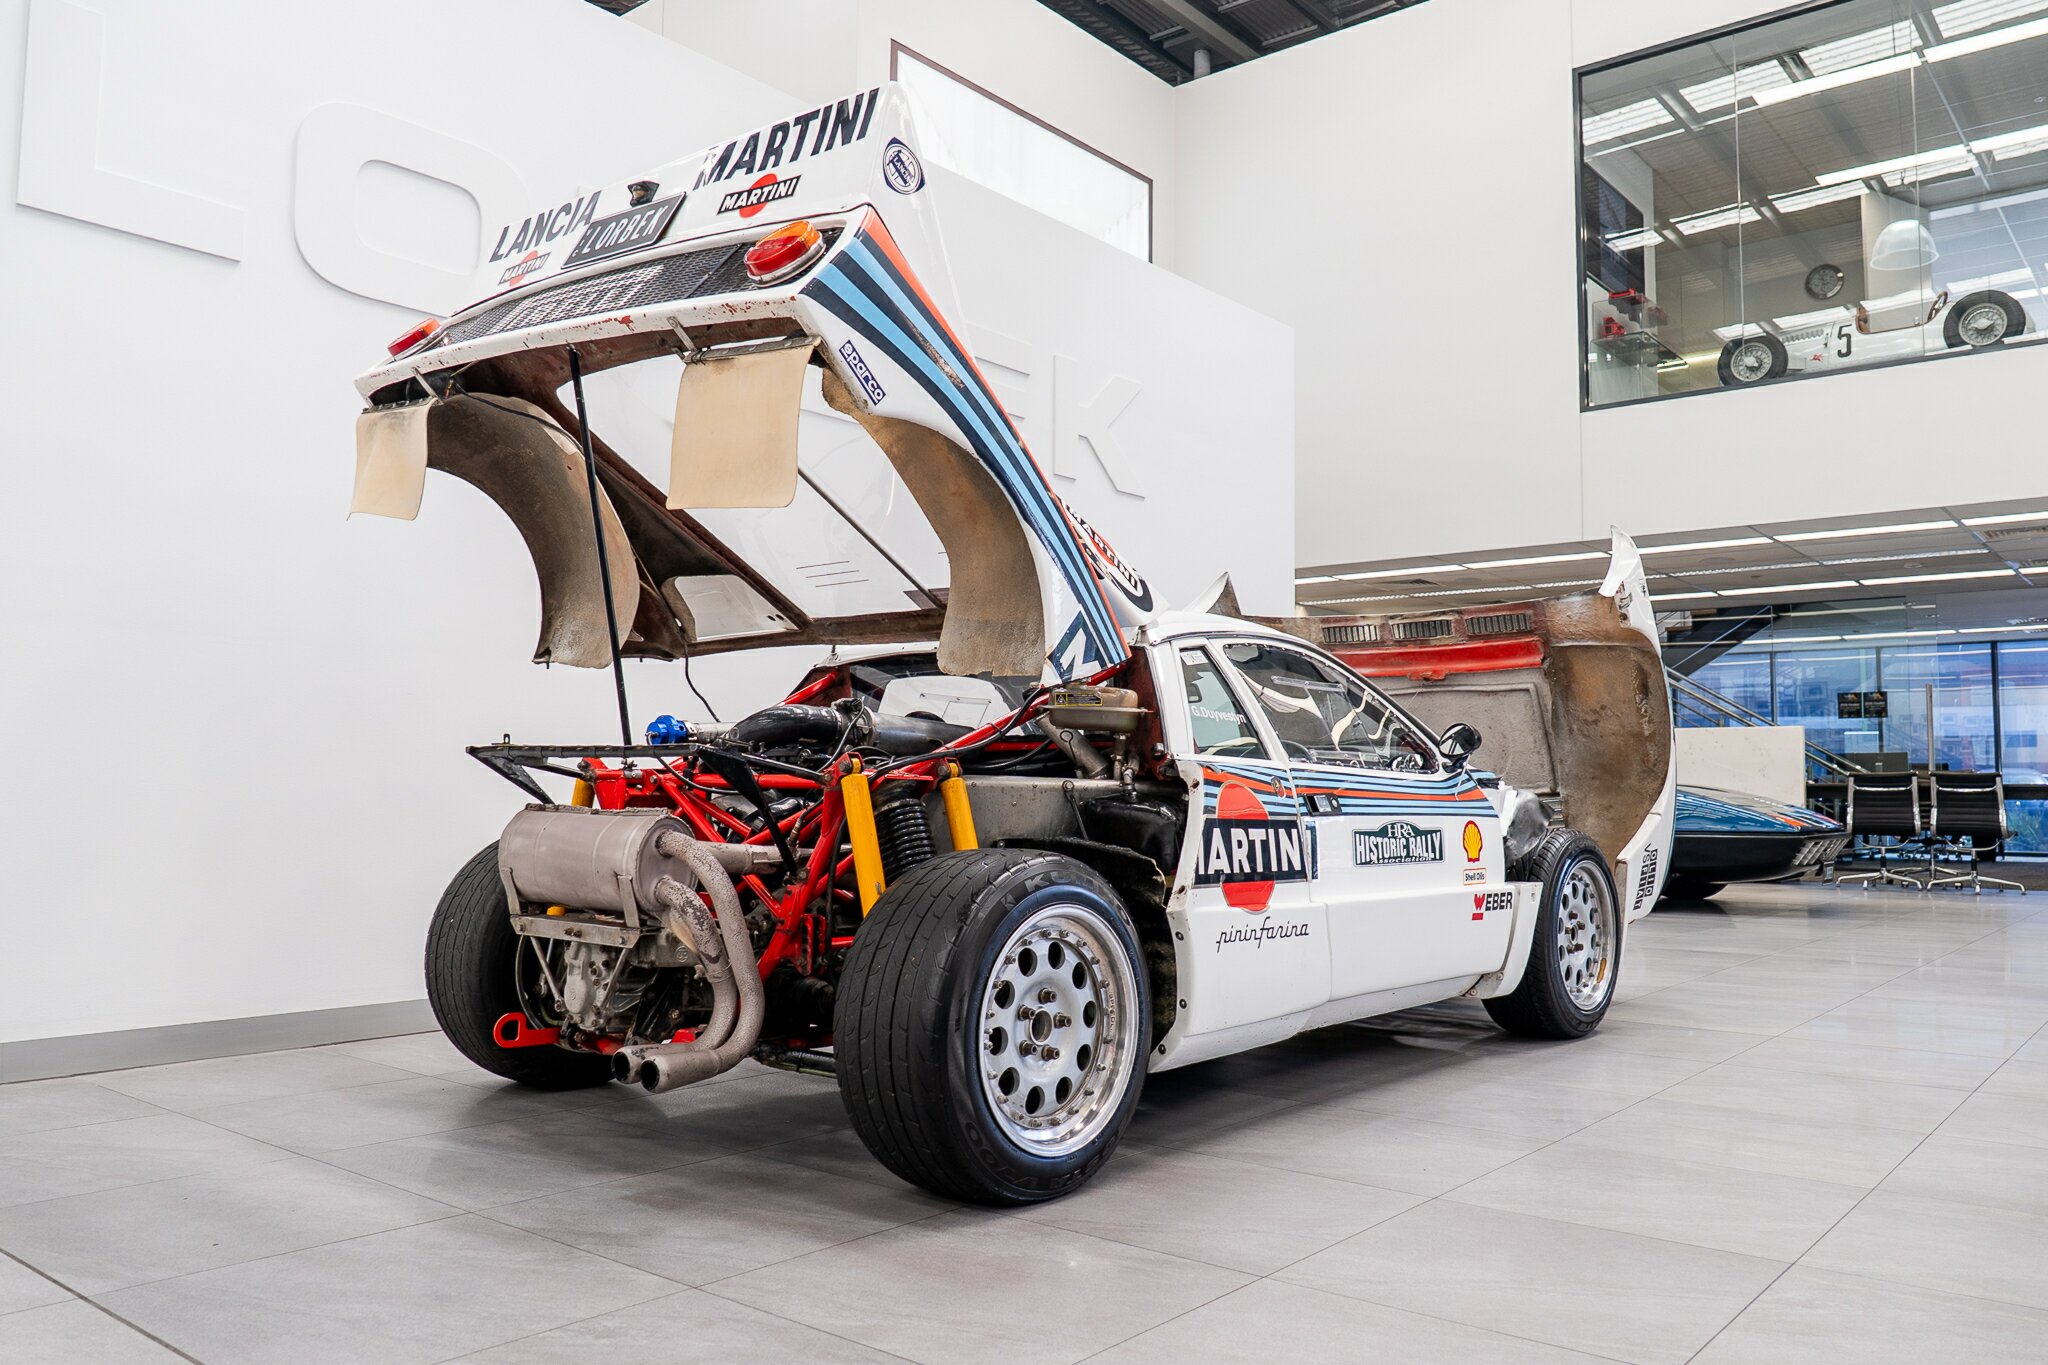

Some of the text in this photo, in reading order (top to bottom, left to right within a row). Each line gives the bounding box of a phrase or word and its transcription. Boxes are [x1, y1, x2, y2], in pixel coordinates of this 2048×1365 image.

[693, 86, 880, 191] MARTINI
[720, 180, 798, 212] MARTINI
[489, 189, 602, 263] LANCIA
[582, 205, 668, 255] LORBEK
[503, 253, 549, 283] MARTINI
[1837, 323, 1853, 358] 5
[842, 343, 884, 402] sparco
[1387, 822, 1416, 838] HRA
[1355, 831, 1441, 865] HISTORIC RALLY
[1370, 855, 1432, 864] Association
[1465, 872, 1476, 882] Shell
[1474, 891, 1513, 912] WEBER
[1216, 916, 1310, 953] pininfarina
